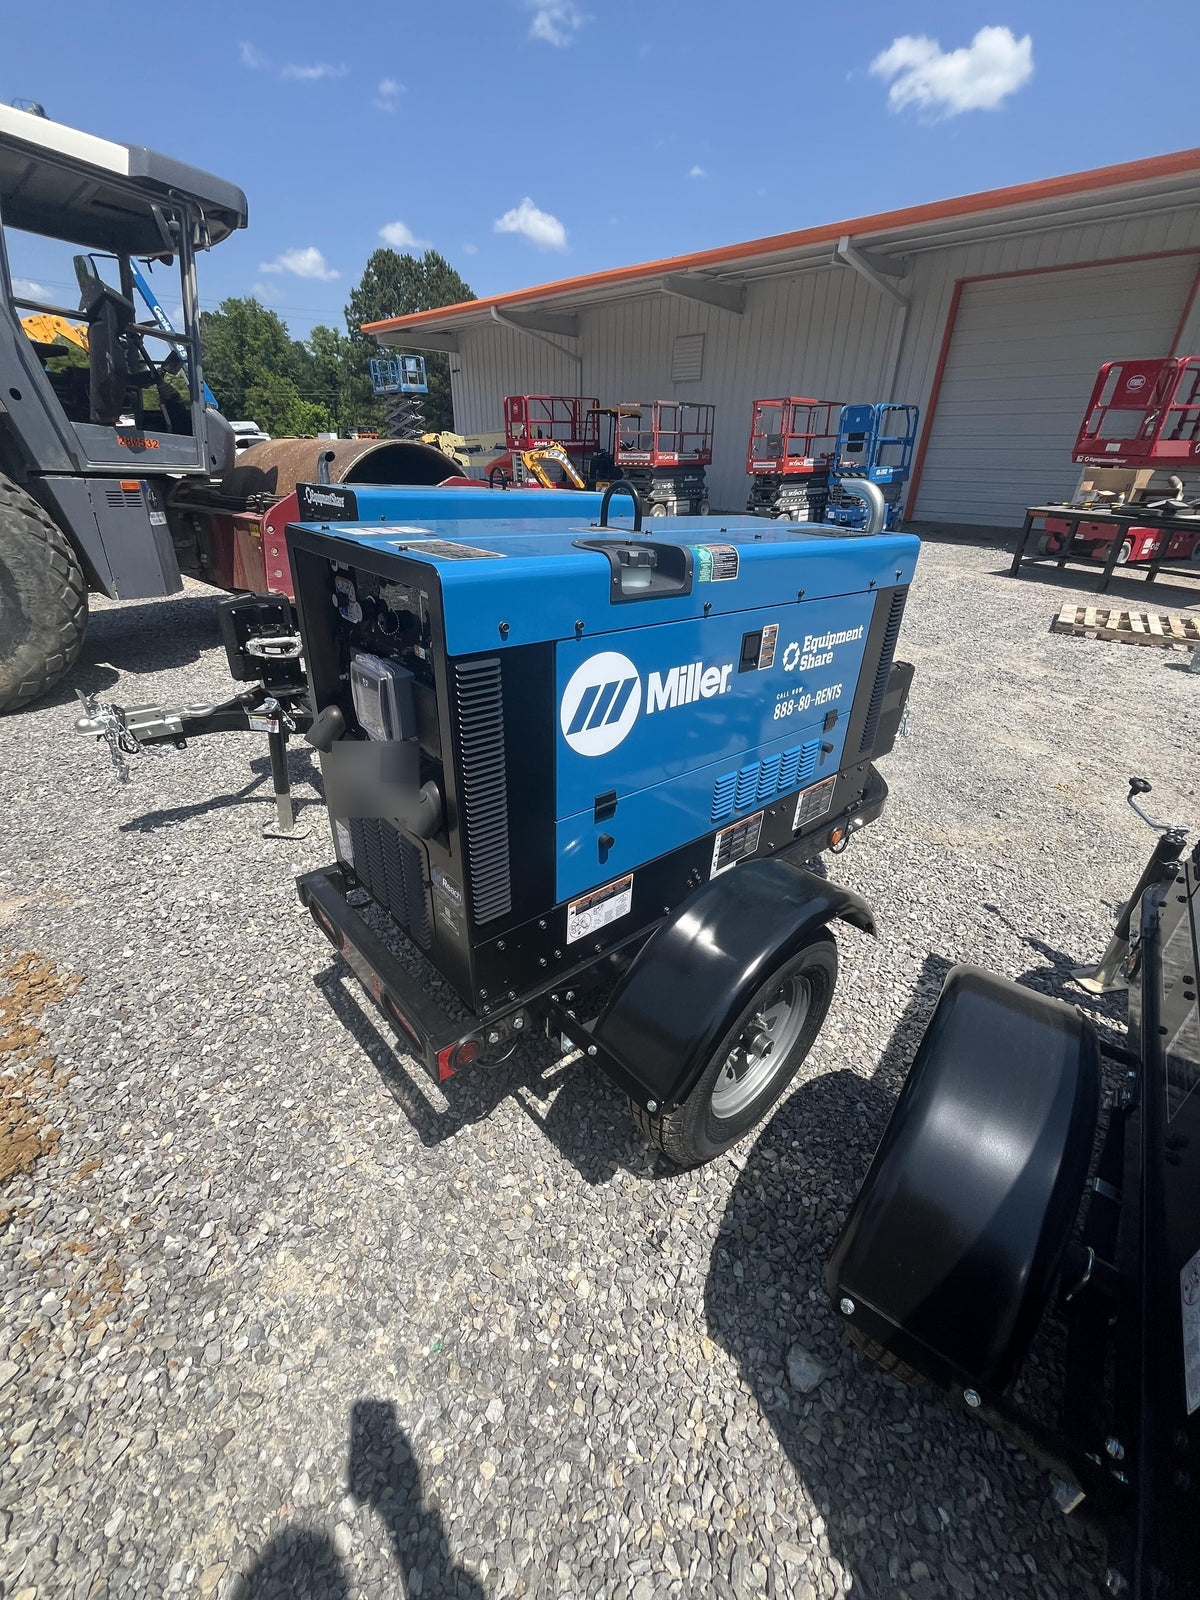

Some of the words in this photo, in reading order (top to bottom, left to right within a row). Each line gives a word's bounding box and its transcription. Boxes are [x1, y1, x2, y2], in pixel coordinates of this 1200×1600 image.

[153, 305, 171, 332] Genie
[118, 436, 159, 449] 280532
[802, 624, 864, 653] Equipment
[799, 651, 834, 671] Share
[646, 661, 734, 715] Miller
[773, 683, 843, 720] 888-80-RENTS
[776, 691, 790, 700] CALL
